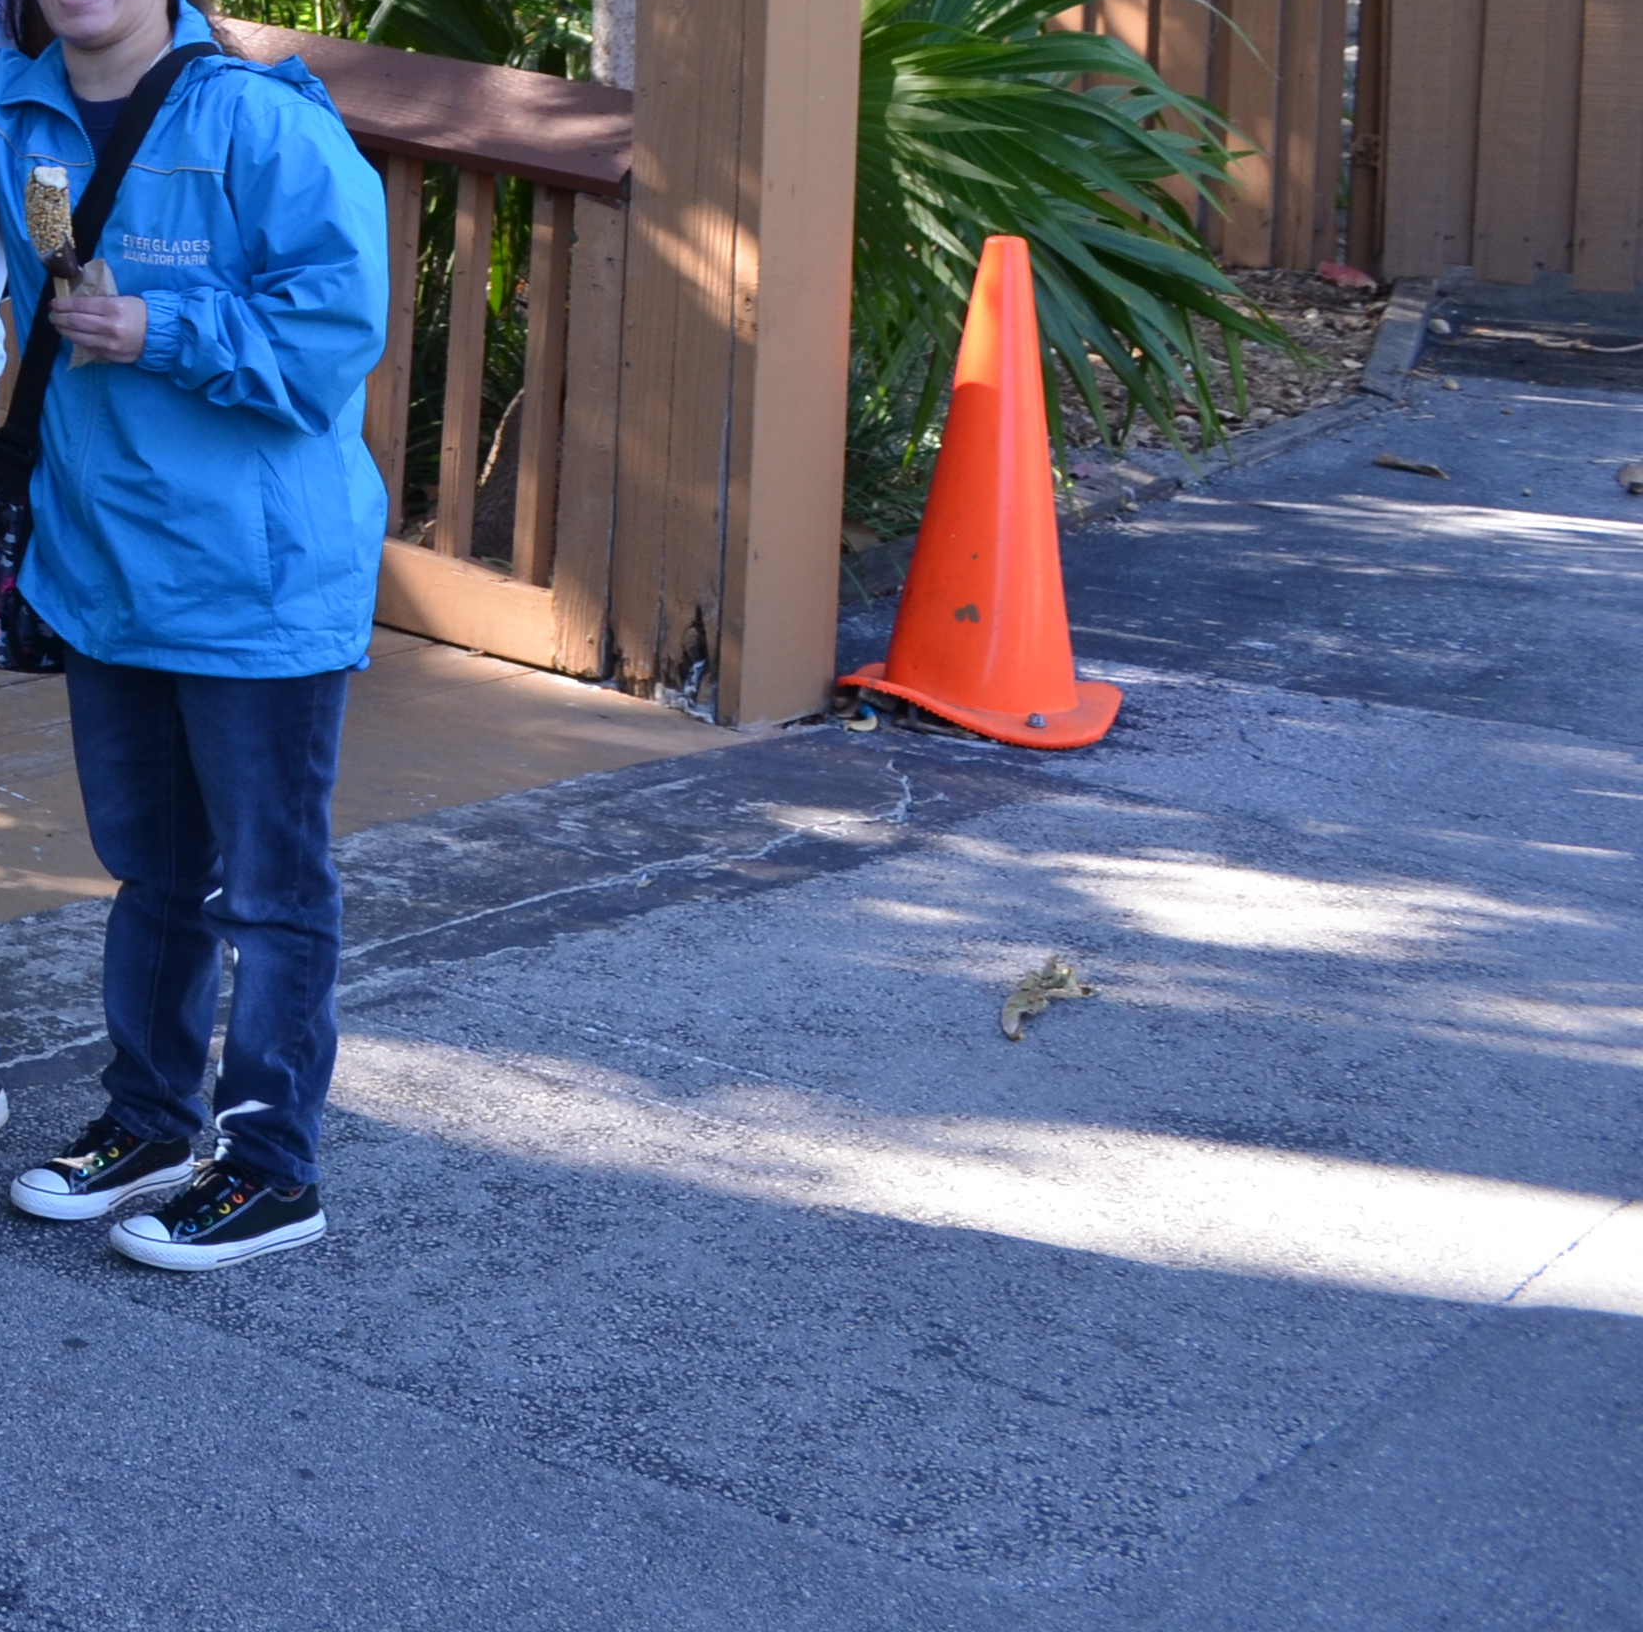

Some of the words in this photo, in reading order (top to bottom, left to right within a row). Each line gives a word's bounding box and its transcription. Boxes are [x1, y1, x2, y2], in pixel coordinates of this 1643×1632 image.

[122, 234, 211, 254] EVERGLADES
[122, 250, 175, 266] ALLIGATOR
[177, 254, 208, 266] FARM
